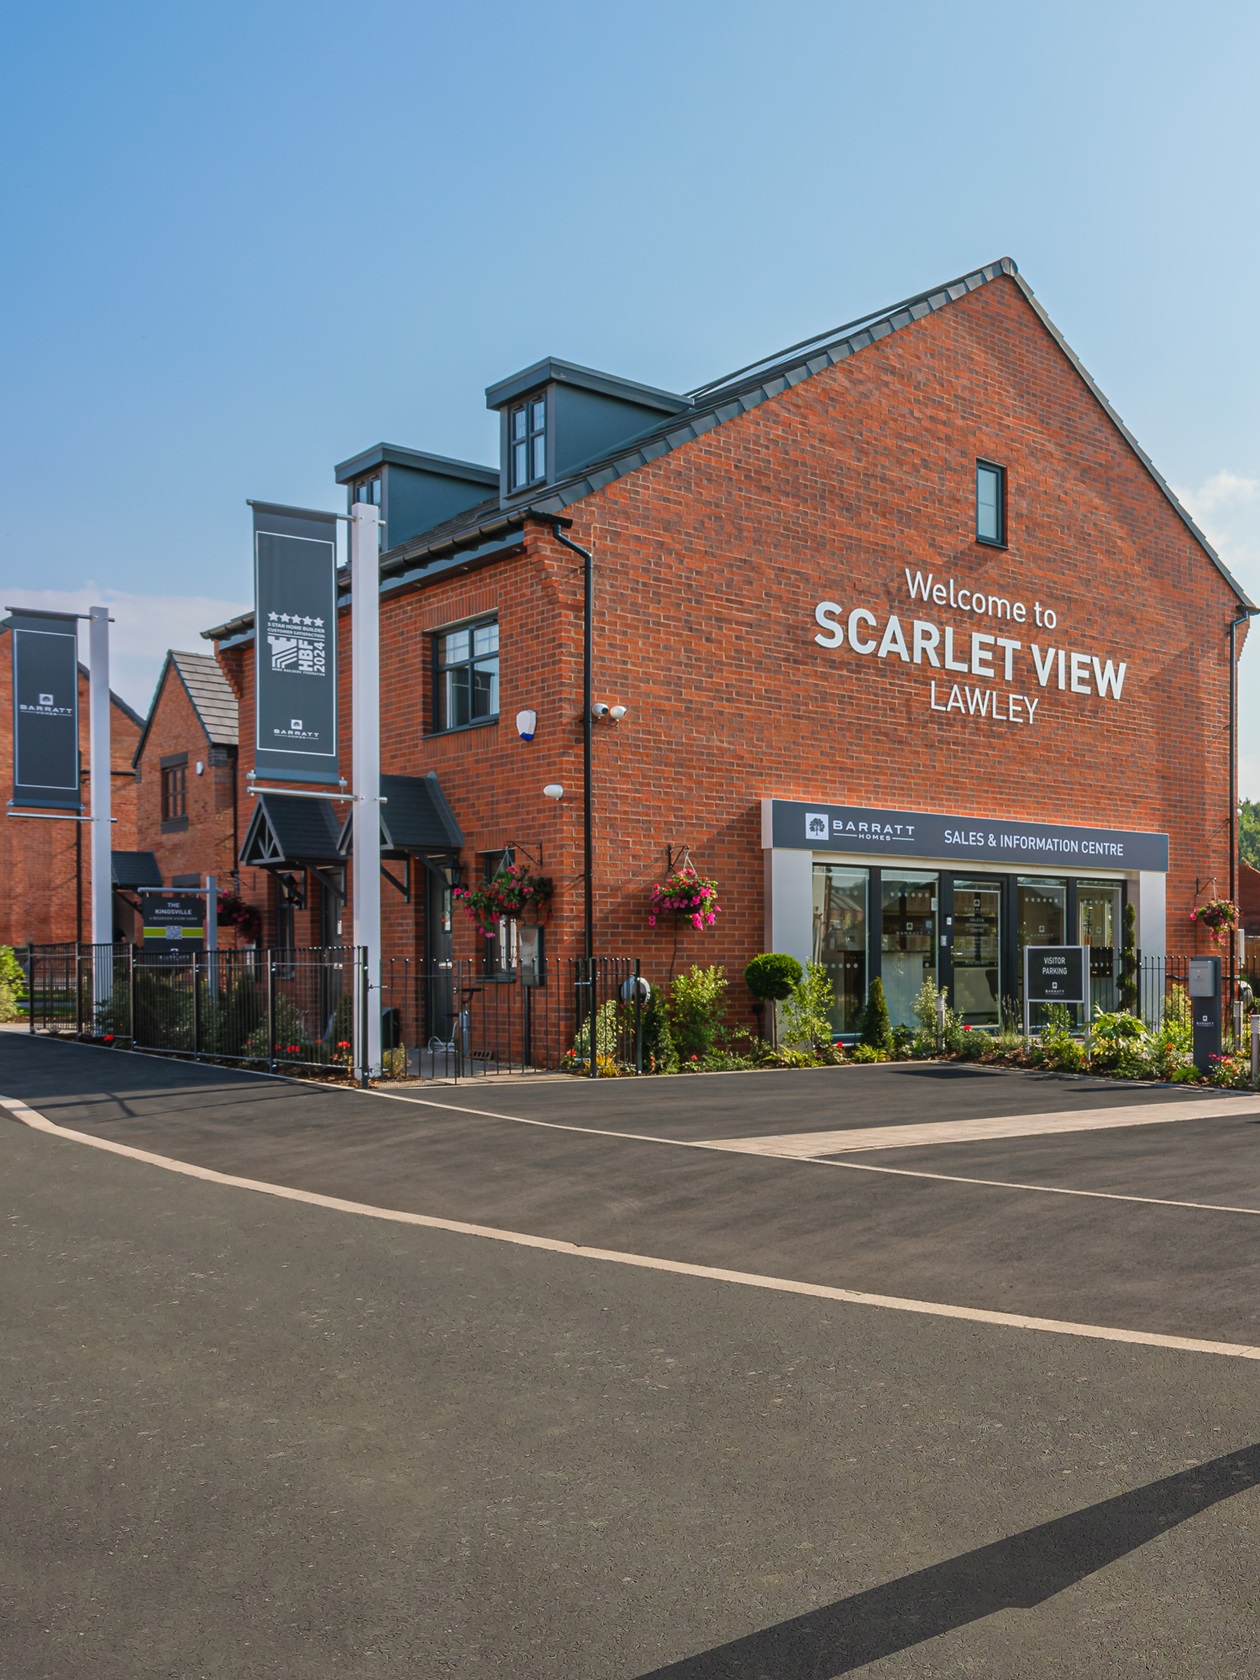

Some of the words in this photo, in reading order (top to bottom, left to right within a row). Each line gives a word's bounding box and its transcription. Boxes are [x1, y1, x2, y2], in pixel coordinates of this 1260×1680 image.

[905, 568, 1026, 622] Welcome
[1034, 601, 1057, 629] to
[298, 640, 313, 671] HBF
[314, 642, 325, 672] 2024
[814, 601, 1021, 681] SCARLET
[1030, 644, 1126, 700] VIEW
[20, 704, 72, 713] BARRATT
[930, 680, 1038, 724] LAWLEY
[274, 729, 319, 737] BARRATT
[833, 820, 915, 835] BARRATT
[944, 830, 984, 846] SALES
[988, 834, 996, 847] &
[1000, 834, 1078, 853] INFORMATION
[1081, 841, 1124, 856] CENTRE
